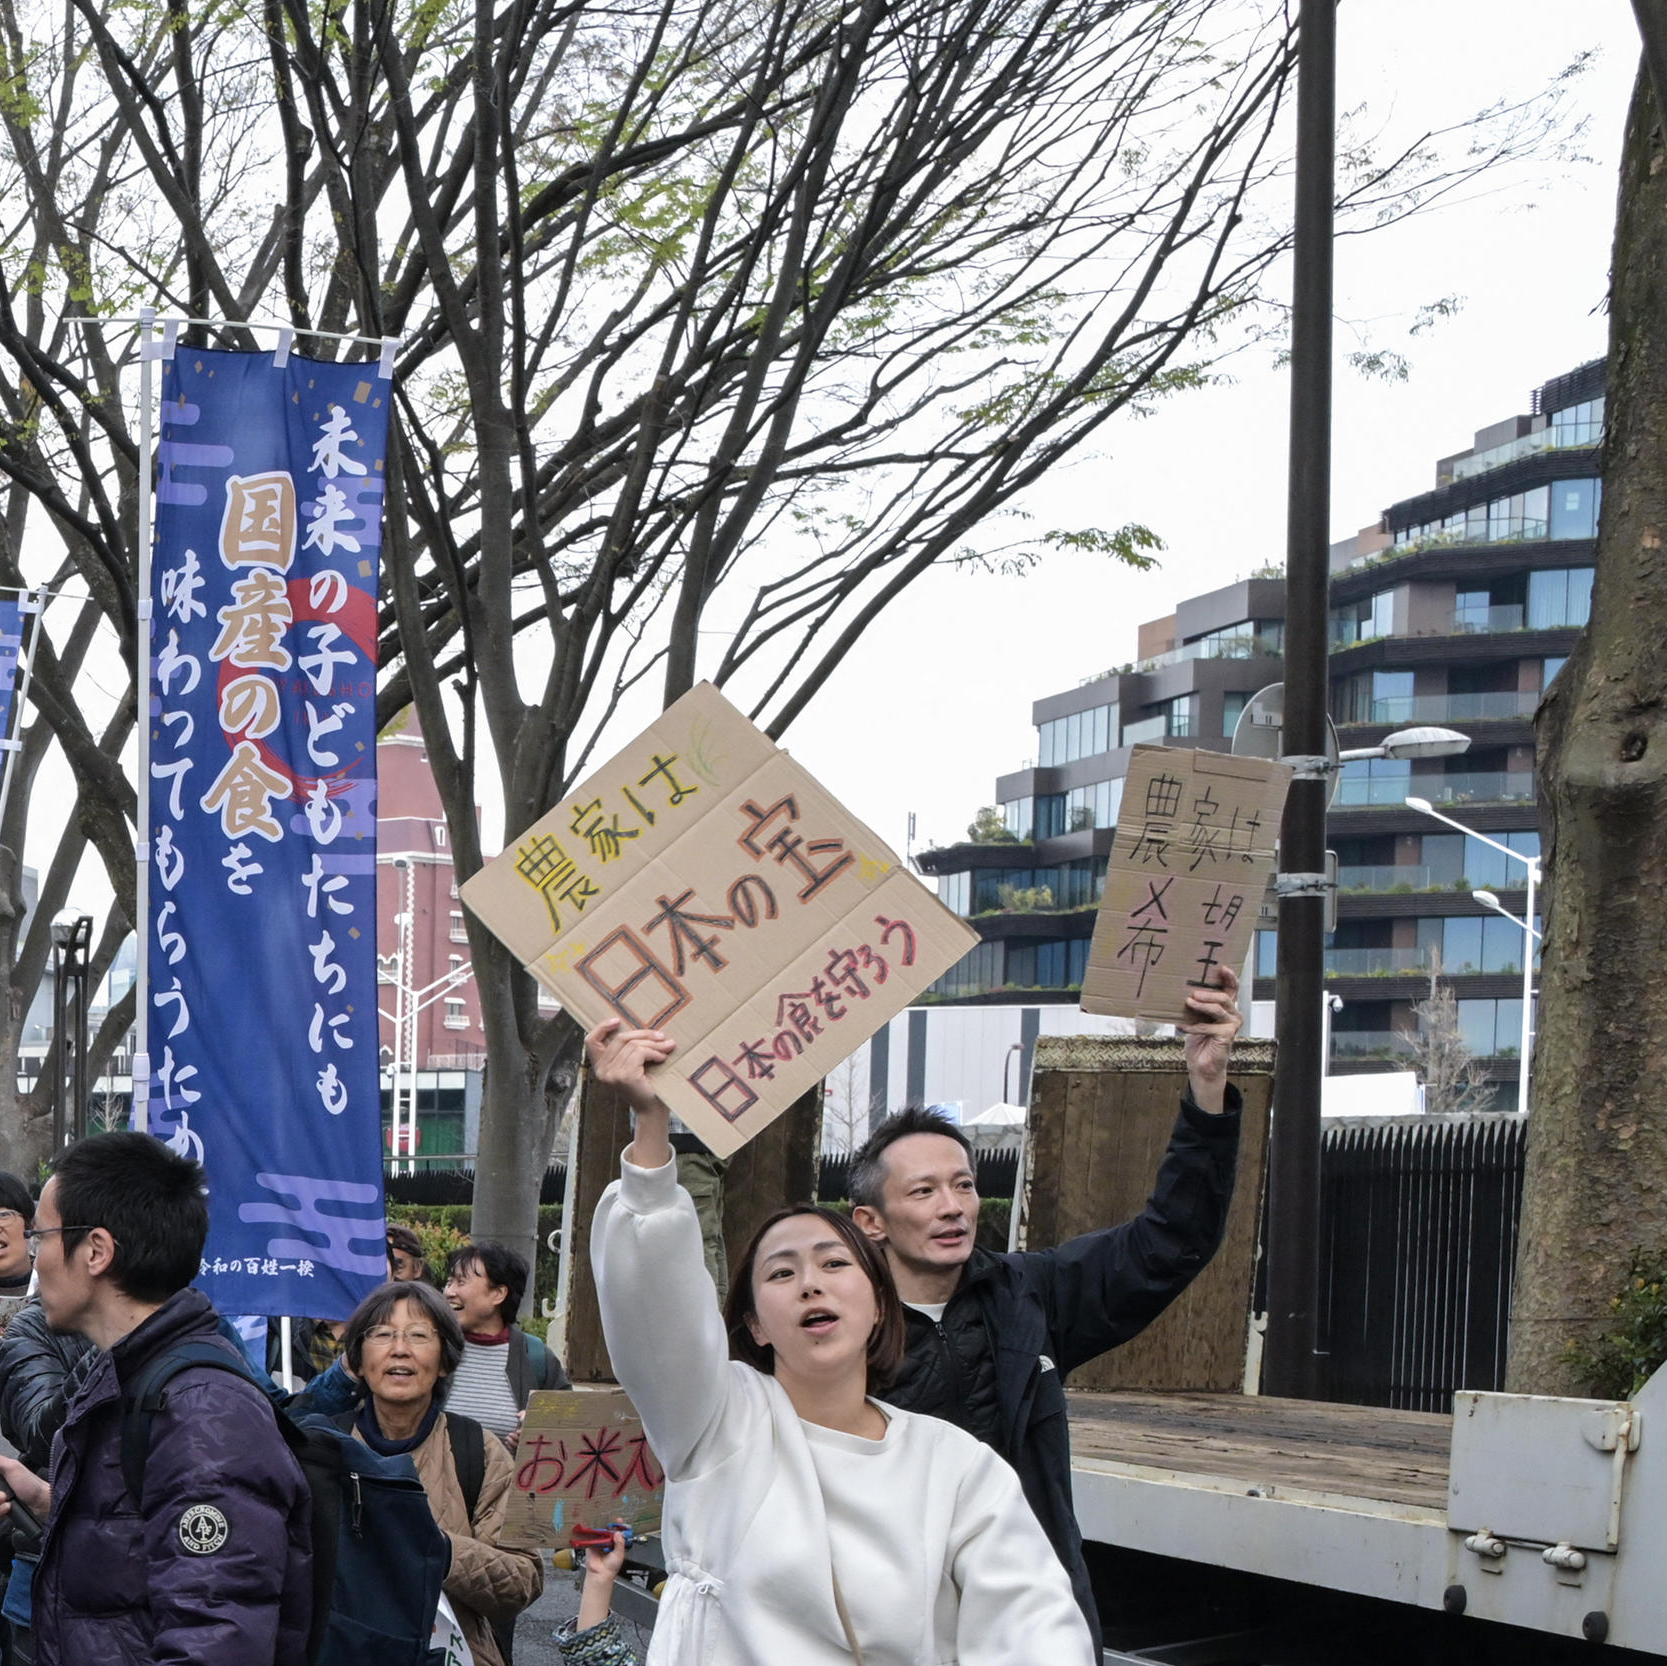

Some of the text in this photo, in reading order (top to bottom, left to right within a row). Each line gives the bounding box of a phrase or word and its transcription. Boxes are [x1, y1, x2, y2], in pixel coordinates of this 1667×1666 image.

[199, 471, 297, 895] 国産の食を
[298, 405, 367, 1115] 未来の子どもたちにも
[150, 549, 209, 1185] 味わってもらうため
[513, 752, 699, 935] 農家は
[574, 793, 857, 1031] 日本の宝
[1129, 773, 1261, 872] 農家は
[687, 914, 918, 1125] 日本の食を守ろう
[199, 1257, 315, 1278] 令和の百姓一揆
